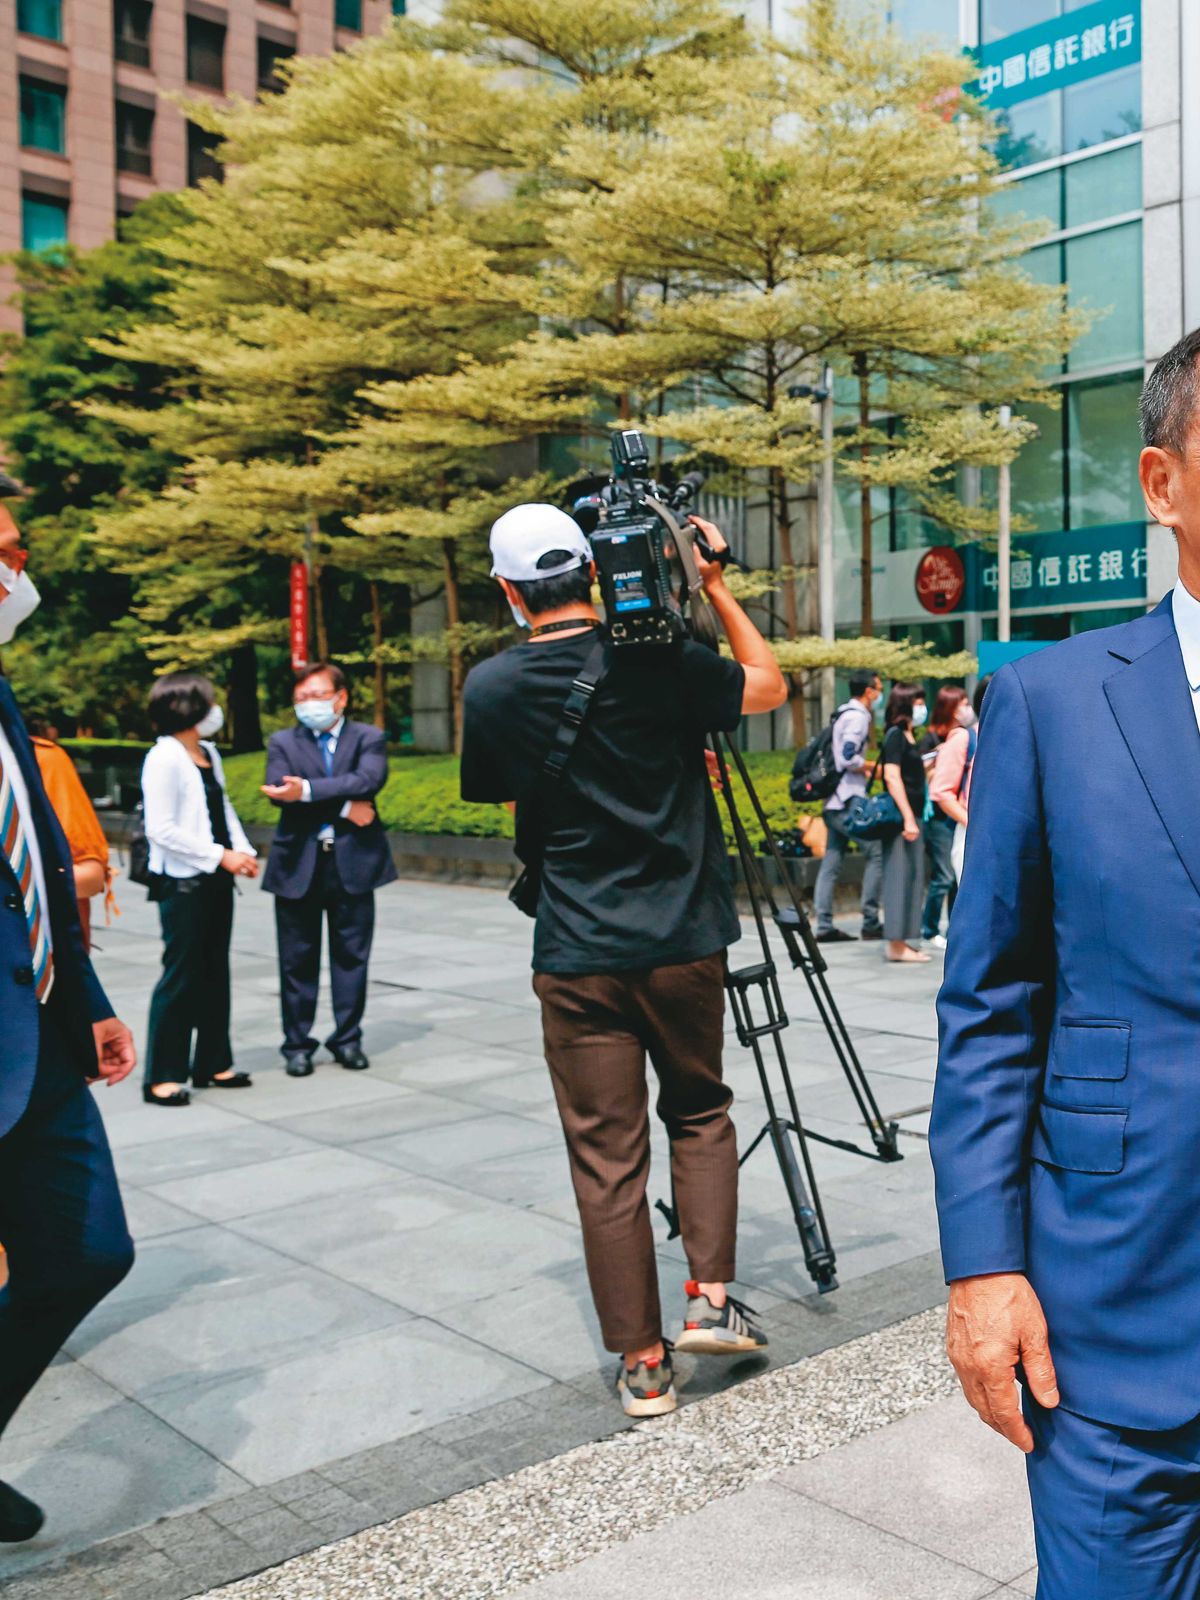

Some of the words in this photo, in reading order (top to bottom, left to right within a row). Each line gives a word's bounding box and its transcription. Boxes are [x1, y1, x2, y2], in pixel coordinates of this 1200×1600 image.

[979, 14, 1135, 93] 中國信託銀行
